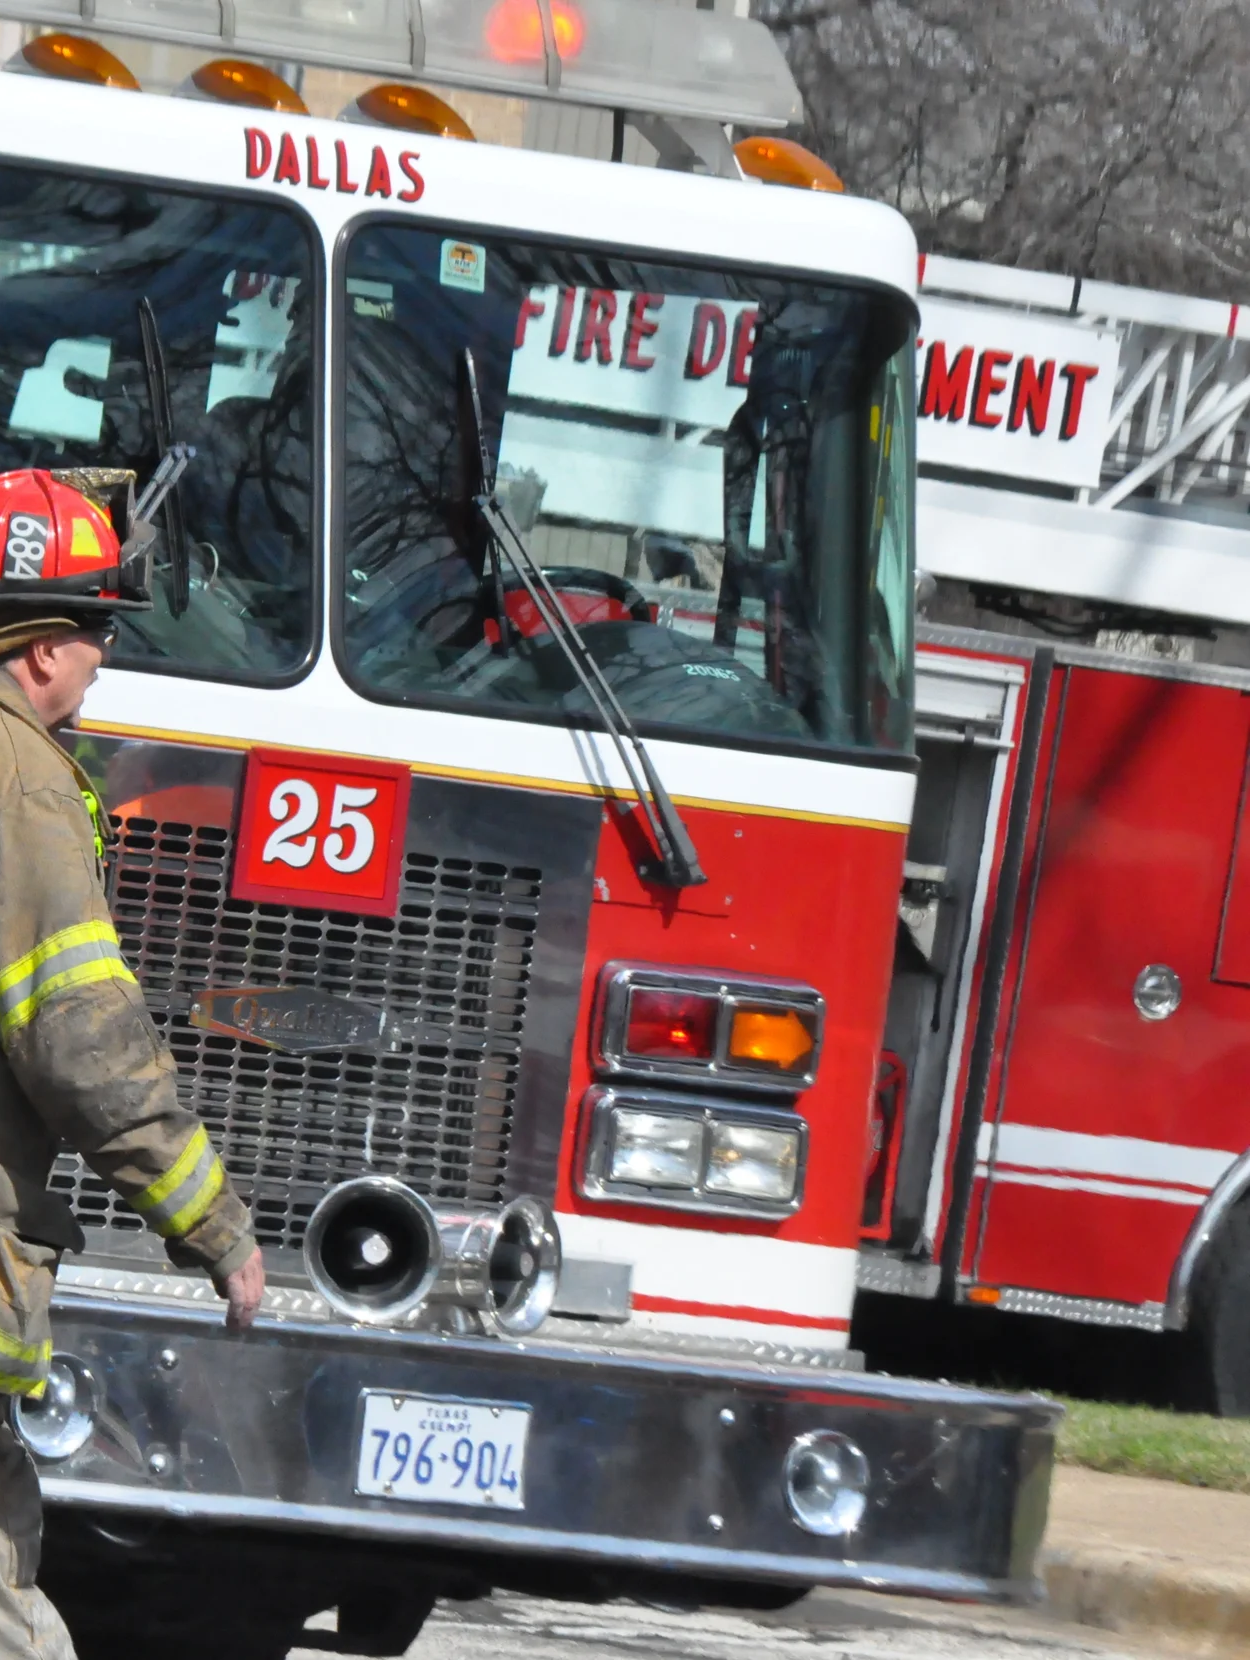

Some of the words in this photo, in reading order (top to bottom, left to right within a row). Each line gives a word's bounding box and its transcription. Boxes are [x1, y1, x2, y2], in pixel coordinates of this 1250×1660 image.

[244, 127, 425, 203] DALLAS
[513, 285, 665, 372] FIRE
[915, 338, 1100, 442] MENT
[4, 516, 47, 579] 684
[262, 778, 378, 874] 25
